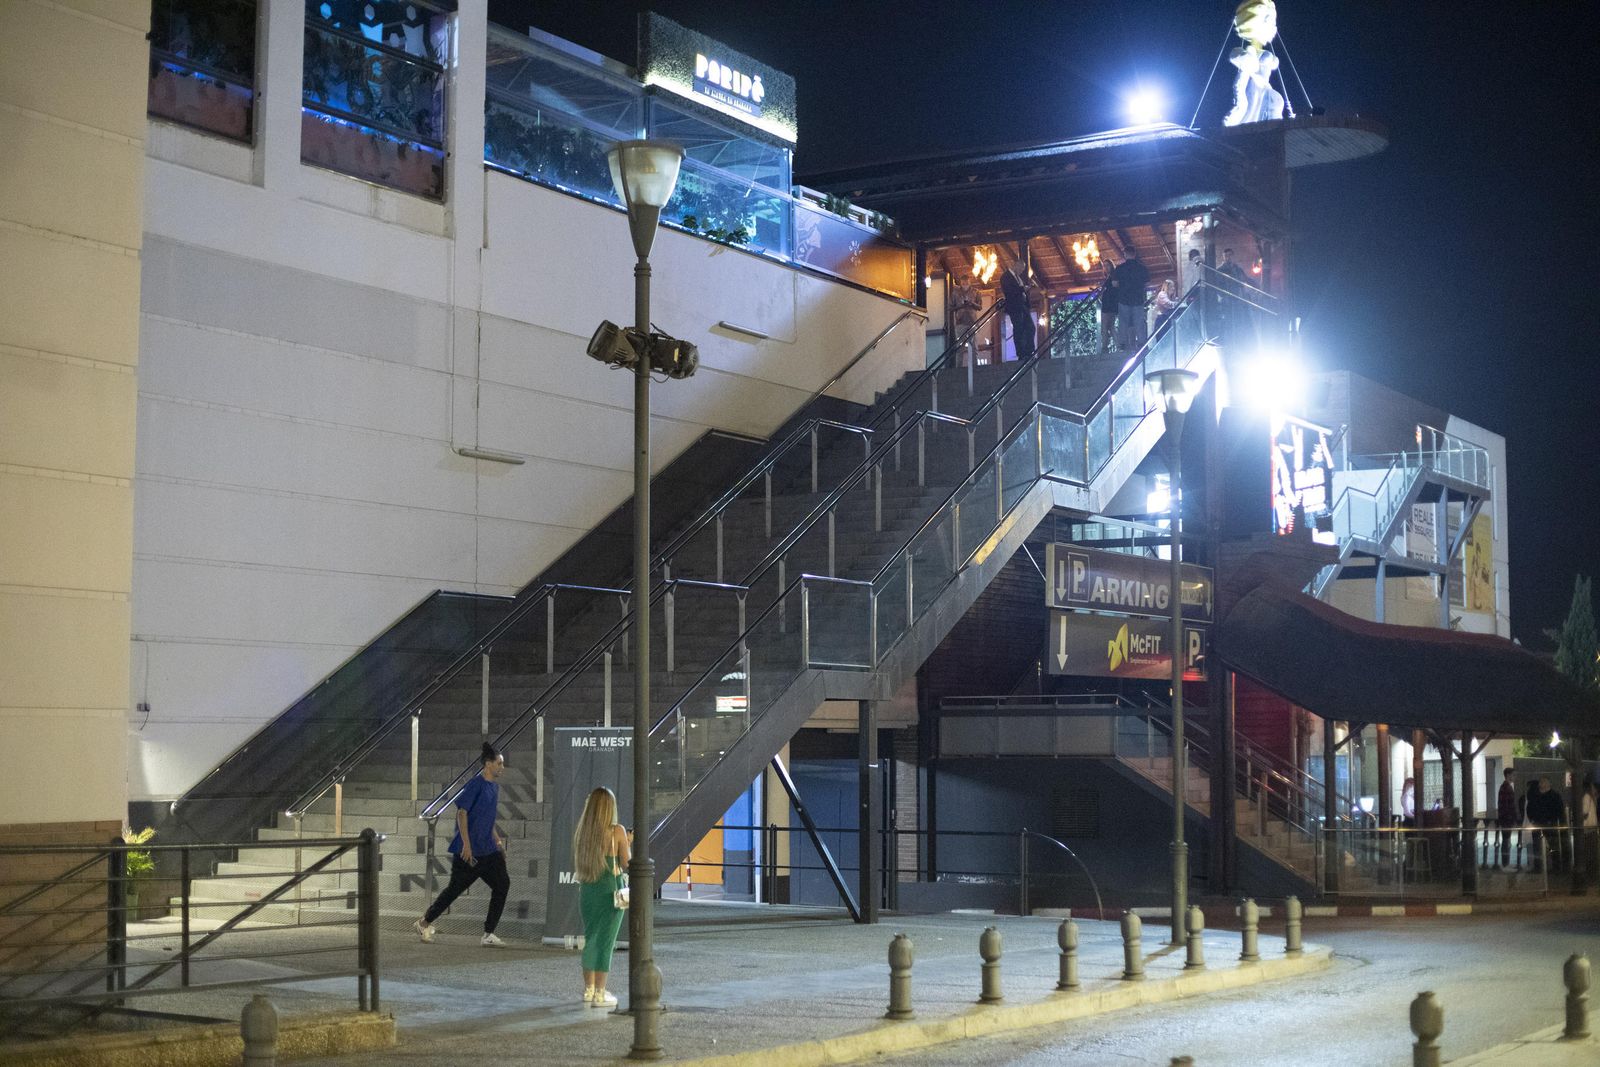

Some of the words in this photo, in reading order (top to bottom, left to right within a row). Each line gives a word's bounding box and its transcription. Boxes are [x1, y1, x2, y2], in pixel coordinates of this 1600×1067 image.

[1130, 633, 1162, 655] McFIT
[571, 737, 597, 747] MAE
[600, 737, 632, 747] WEST
